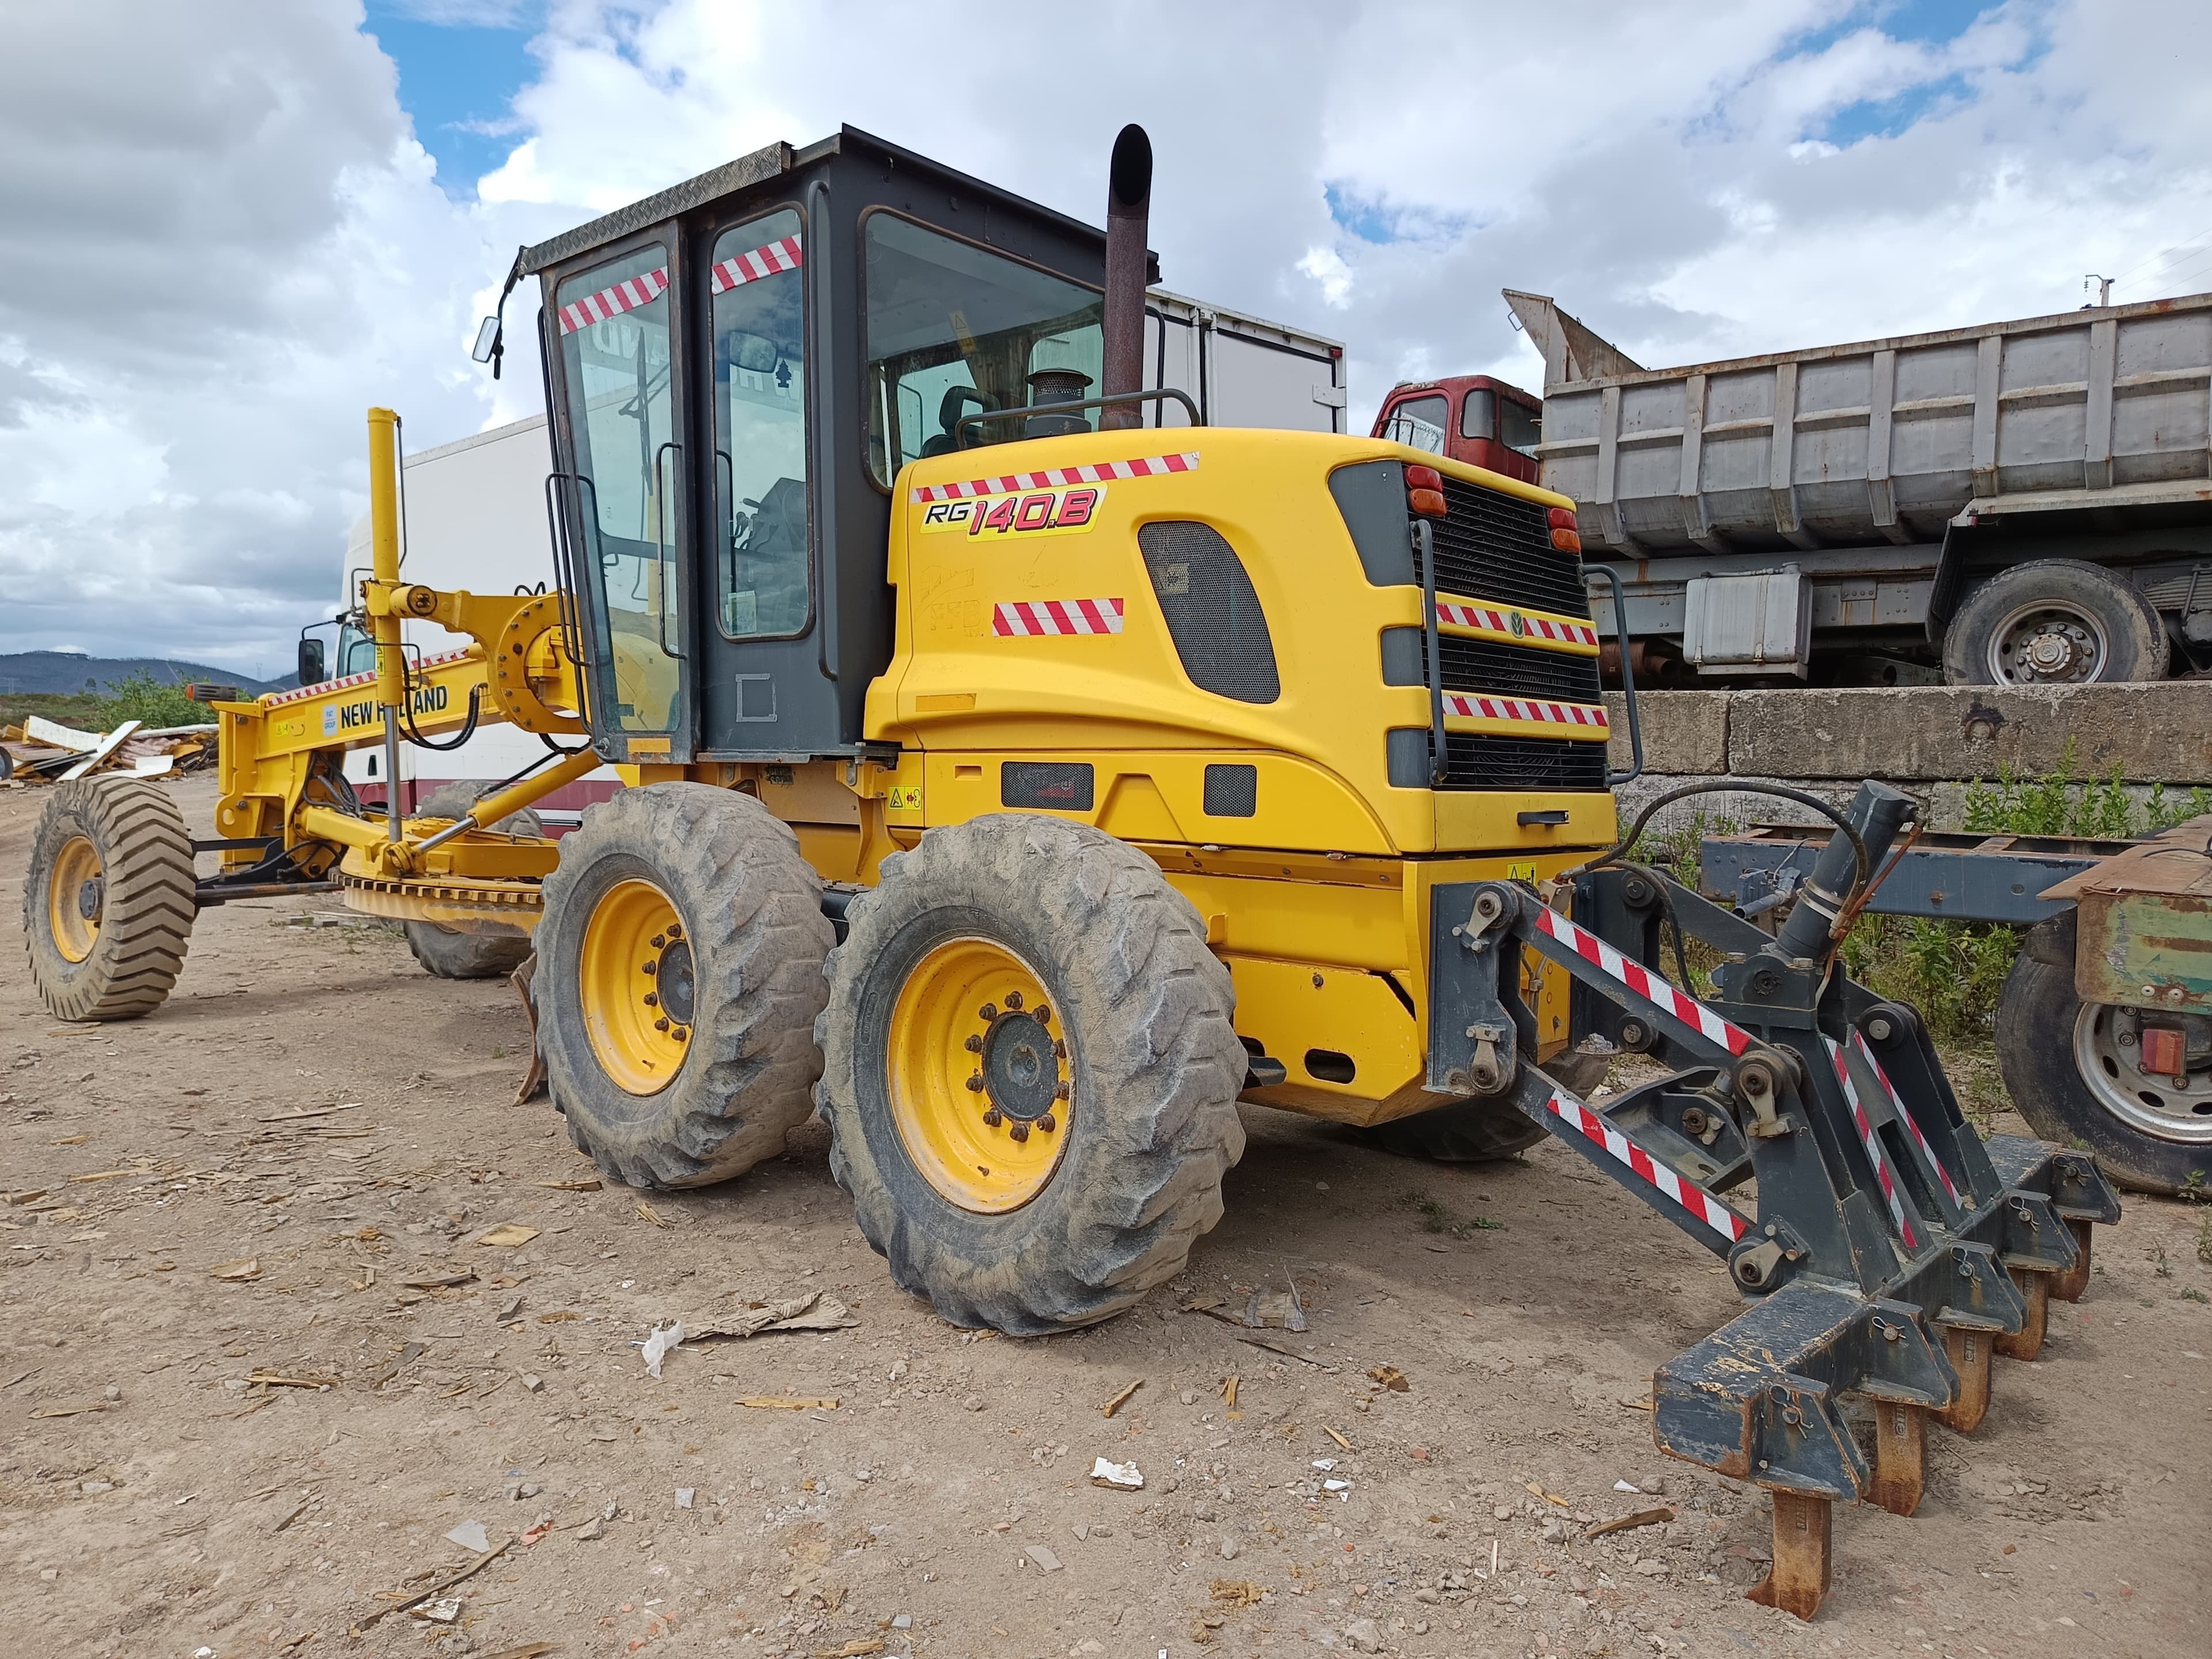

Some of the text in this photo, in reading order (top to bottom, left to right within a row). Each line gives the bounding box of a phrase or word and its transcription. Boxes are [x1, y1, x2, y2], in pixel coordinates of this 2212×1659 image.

[925, 488, 1098, 536] RG 140.B
[324, 720, 336, 729] GROUP
[341, 700, 373, 729] NEW
